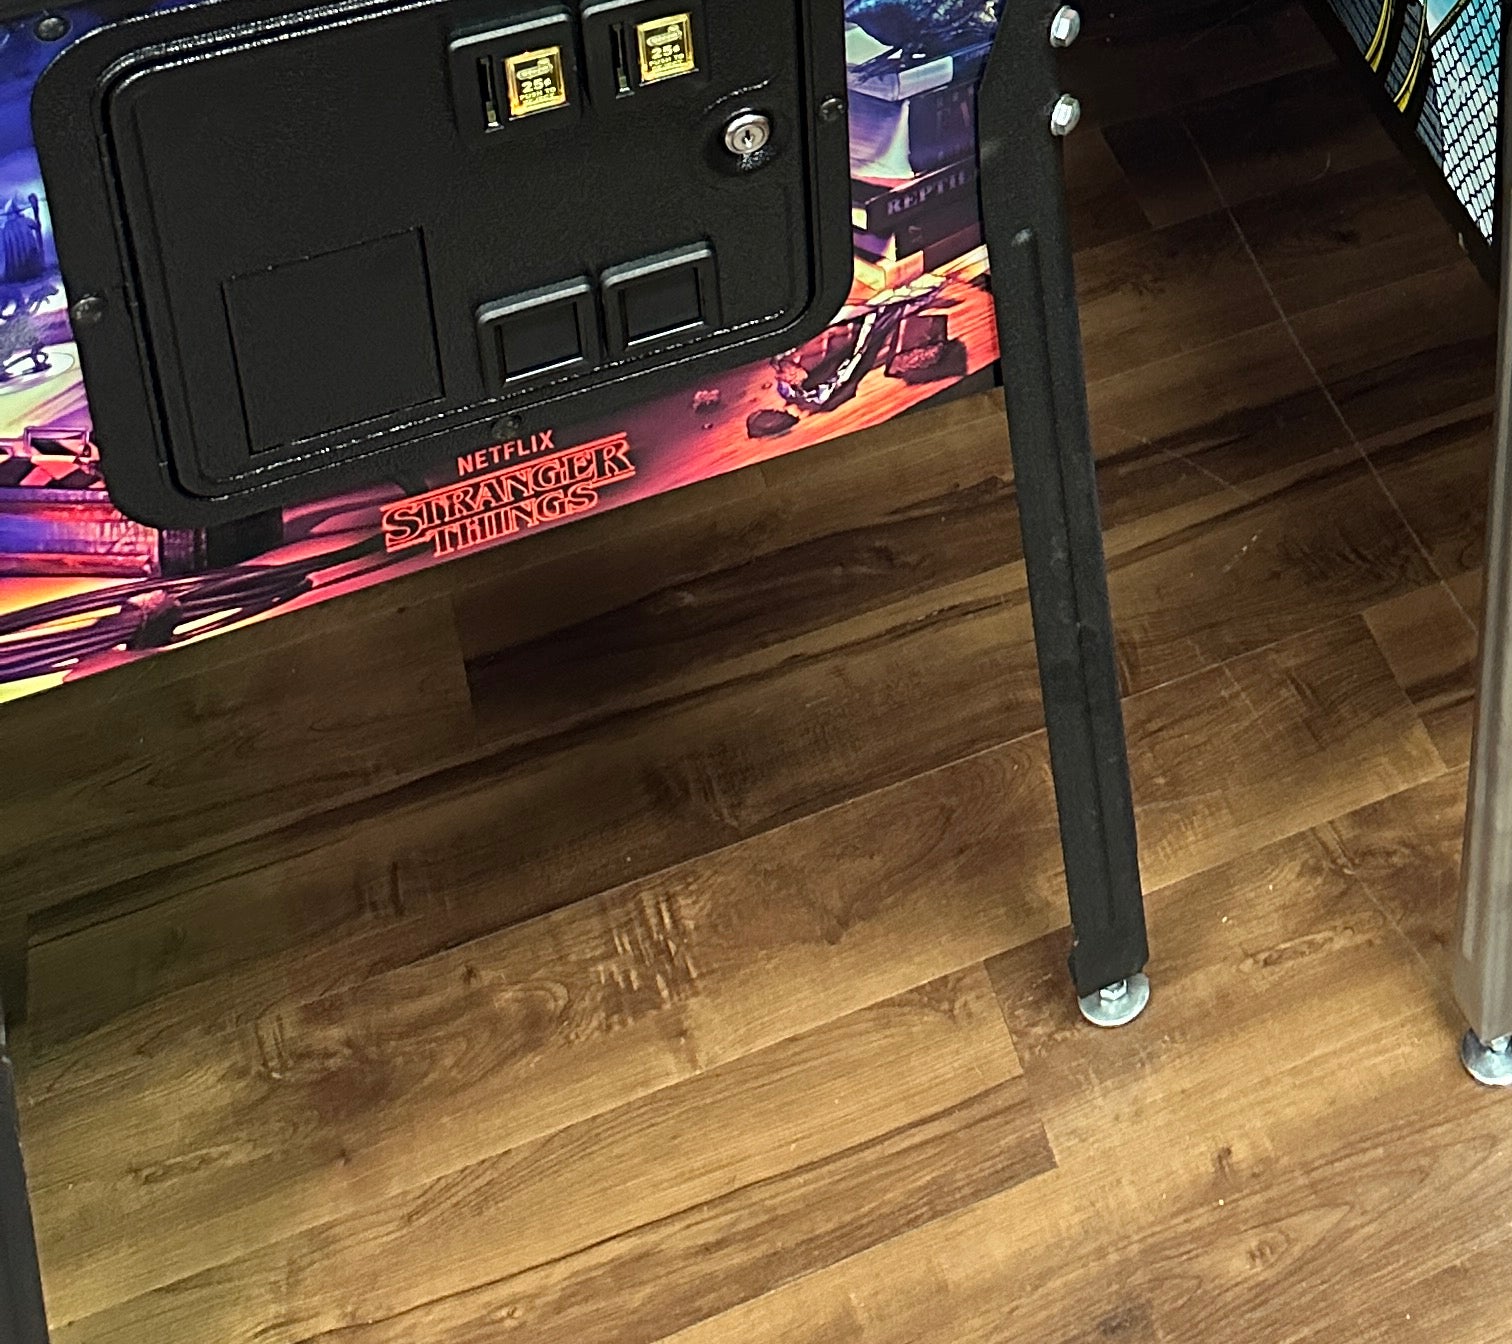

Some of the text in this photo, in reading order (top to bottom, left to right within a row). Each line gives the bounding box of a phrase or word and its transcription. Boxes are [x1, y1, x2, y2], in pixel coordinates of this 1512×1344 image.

[648, 52, 685, 67] PUSH TO
[651, 44, 681, 61] 25¢
[519, 86, 557, 102] PUSH TO
[521, 77, 552, 94] 25¢
[457, 429, 556, 477] NETFLIX
[381, 432, 636, 552] STRANGER
[433, 480, 600, 558] THINGS
